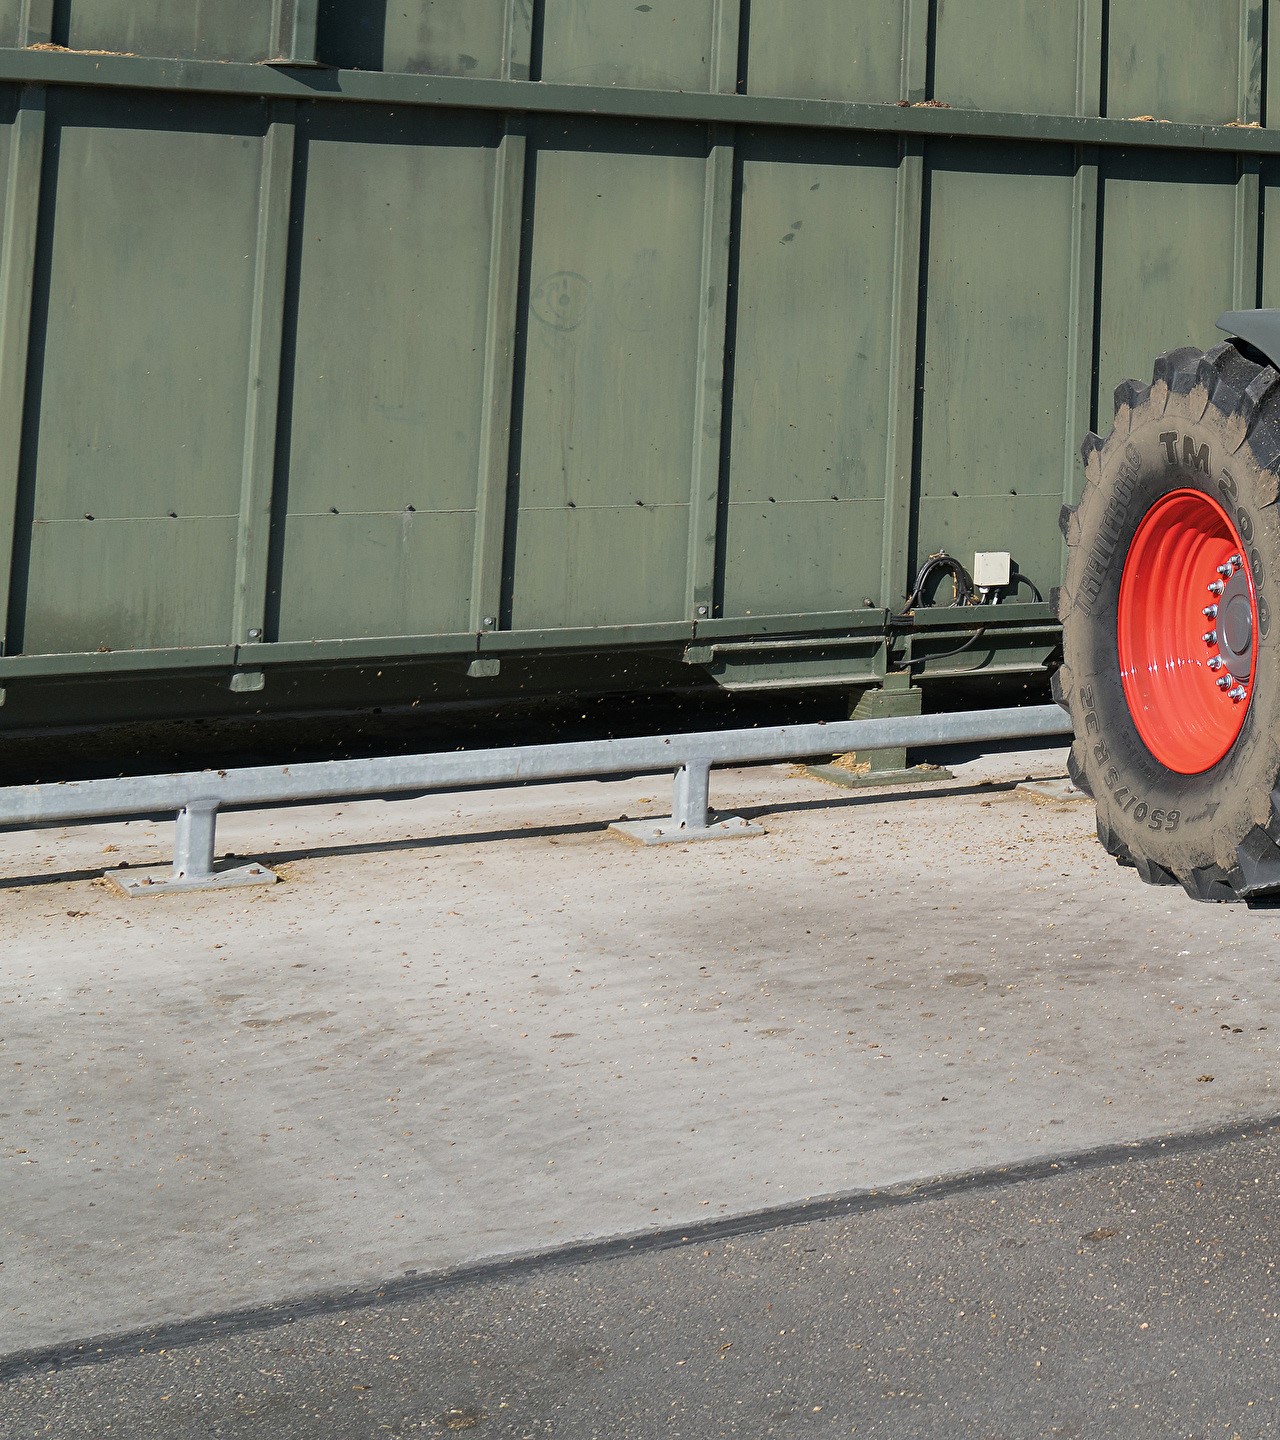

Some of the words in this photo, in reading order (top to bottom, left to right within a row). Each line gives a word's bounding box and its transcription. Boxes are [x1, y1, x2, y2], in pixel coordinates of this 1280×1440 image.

[1073, 442, 1142, 617] TRELLEBORG
[1158, 429, 1212, 478] TM
[1217, 468, 1271, 638] 2000
